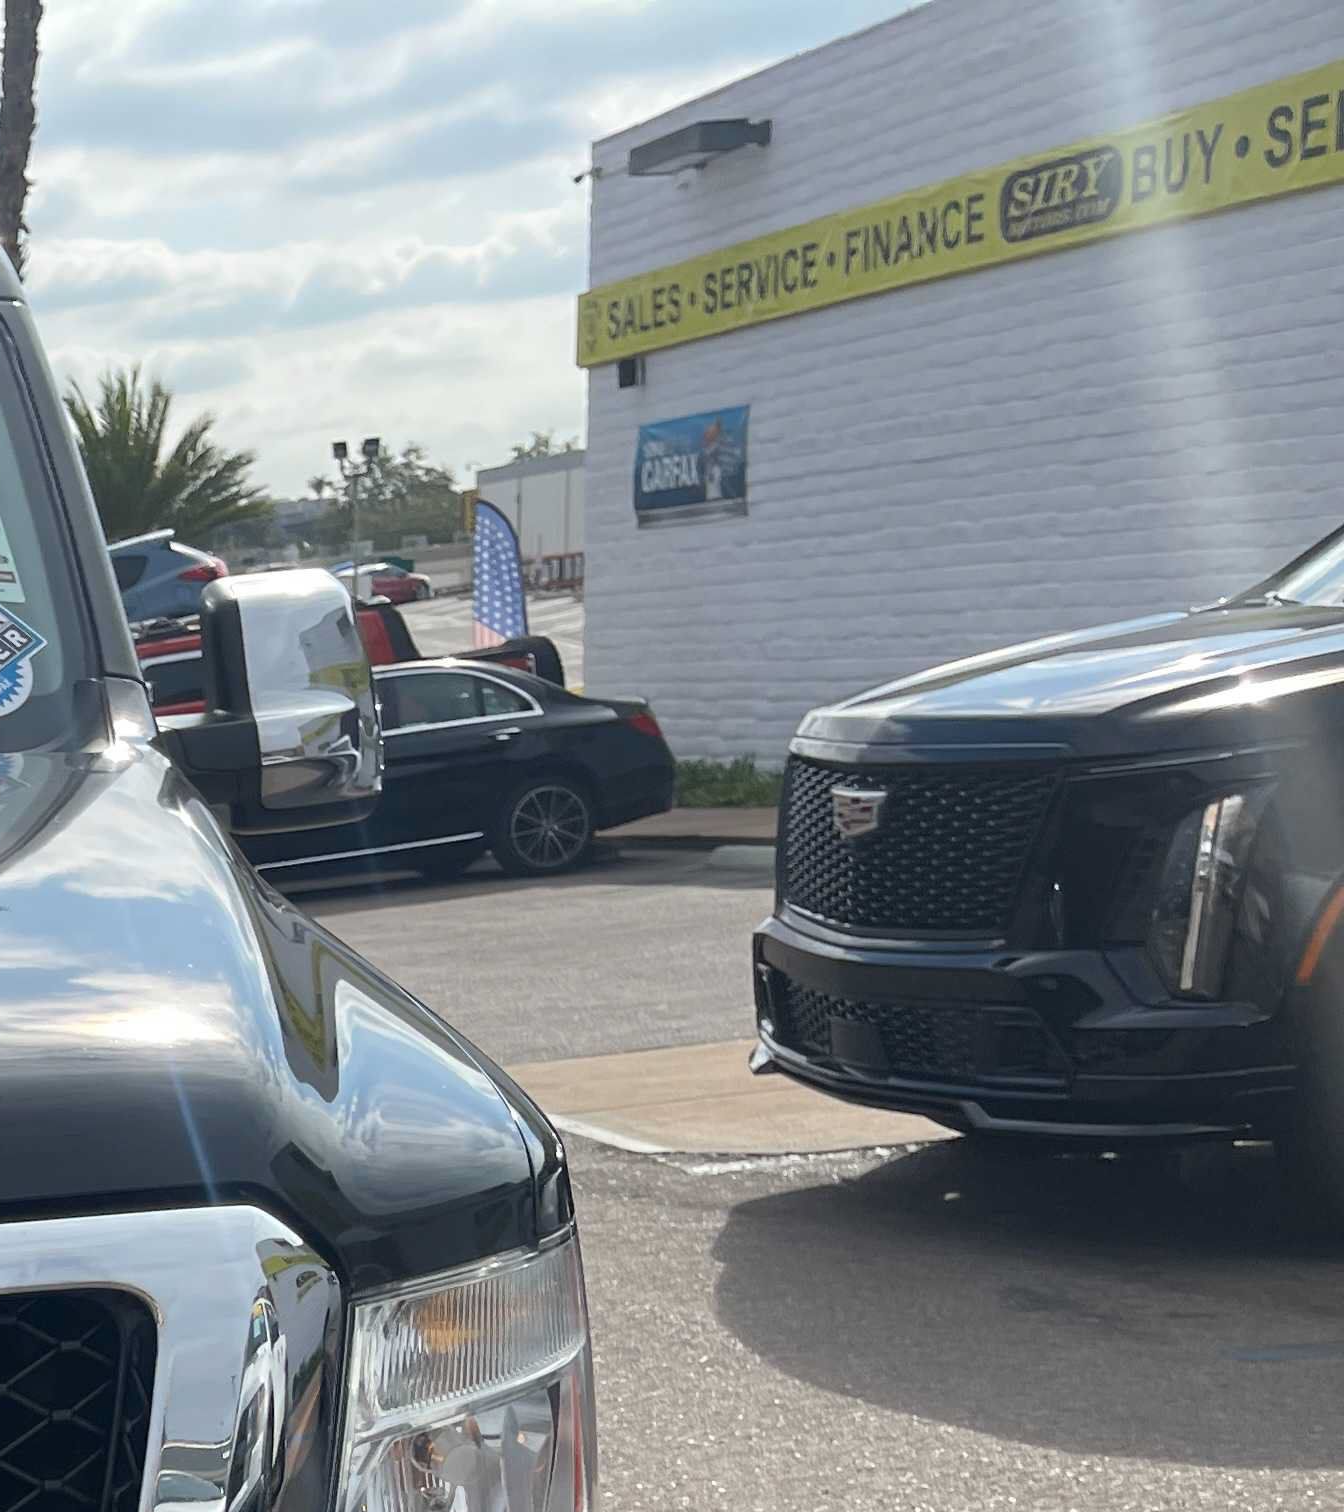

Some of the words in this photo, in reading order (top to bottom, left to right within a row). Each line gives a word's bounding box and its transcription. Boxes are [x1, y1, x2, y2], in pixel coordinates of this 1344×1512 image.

[1008, 153, 1115, 218] SIRY
[1131, 123, 1225, 204] BUY
[606, 282, 682, 341] SALES
[702, 241, 820, 316] SERVICE
[843, 192, 986, 277] FINANCE
